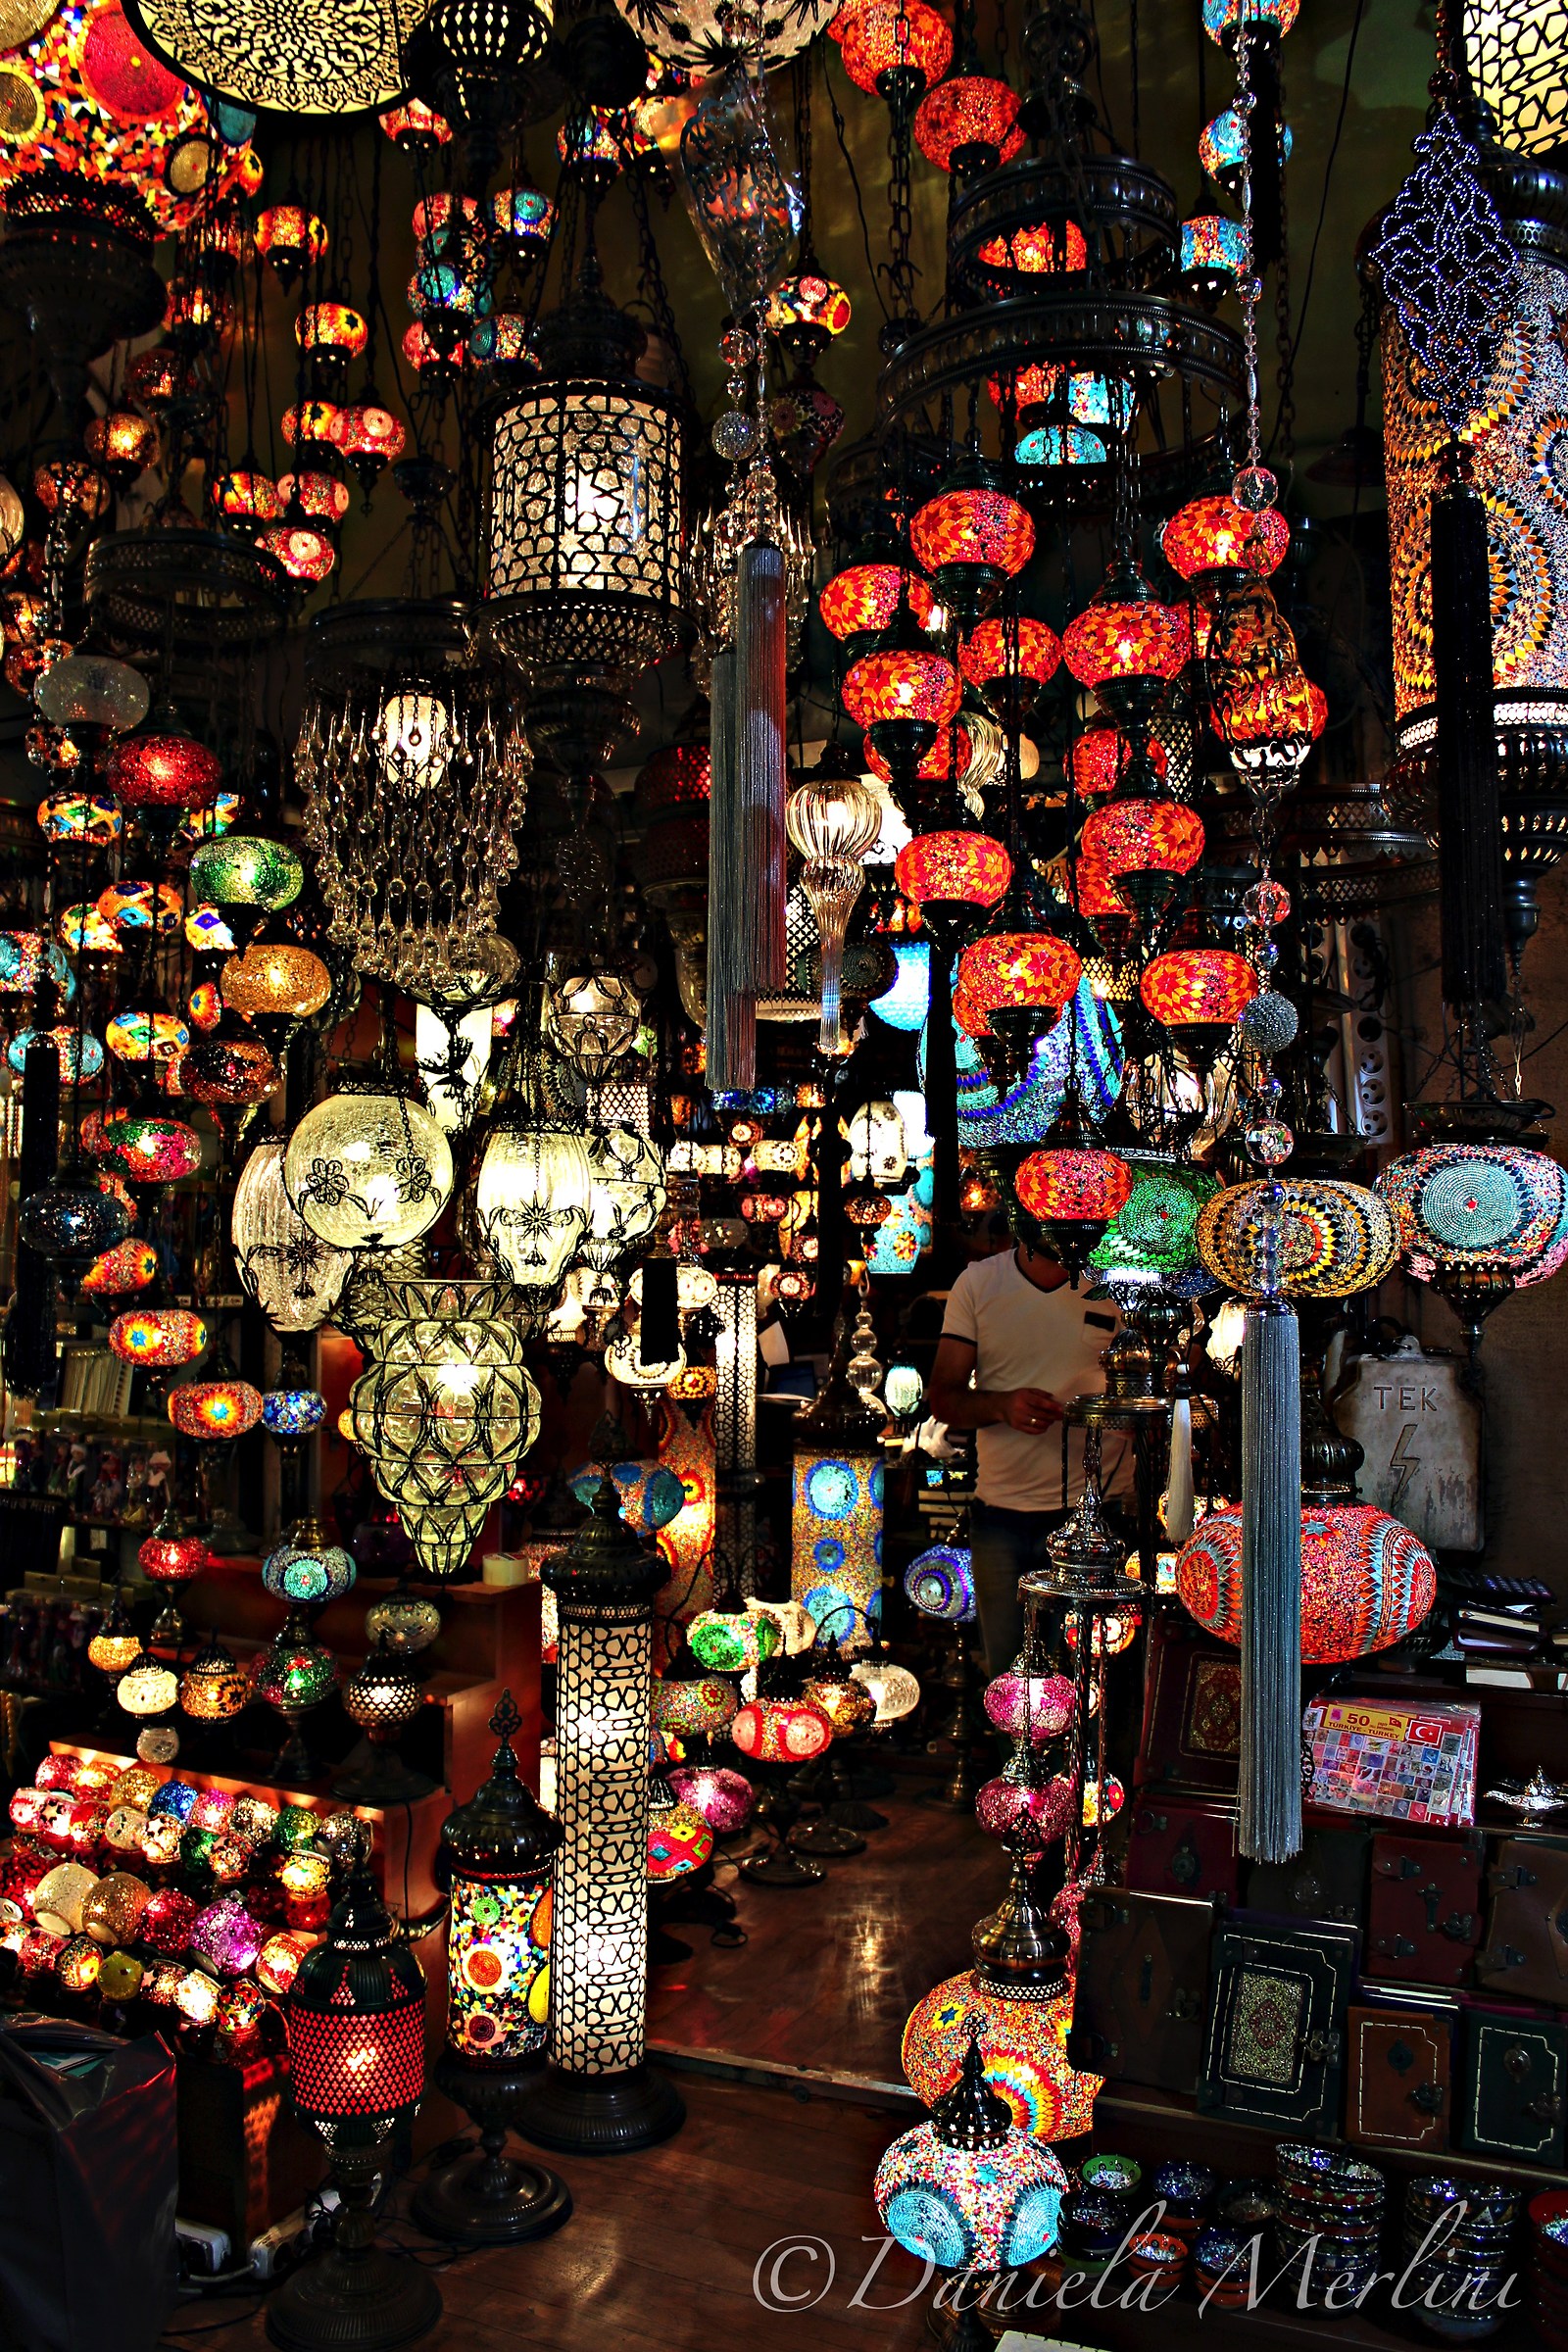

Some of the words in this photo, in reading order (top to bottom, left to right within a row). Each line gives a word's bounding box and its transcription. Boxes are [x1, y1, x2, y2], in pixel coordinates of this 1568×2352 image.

[1374, 1386, 1438, 1411] TEK
[1347, 1713, 1370, 1726] 50
[1368, 1728, 1399, 1739] TURKEY
